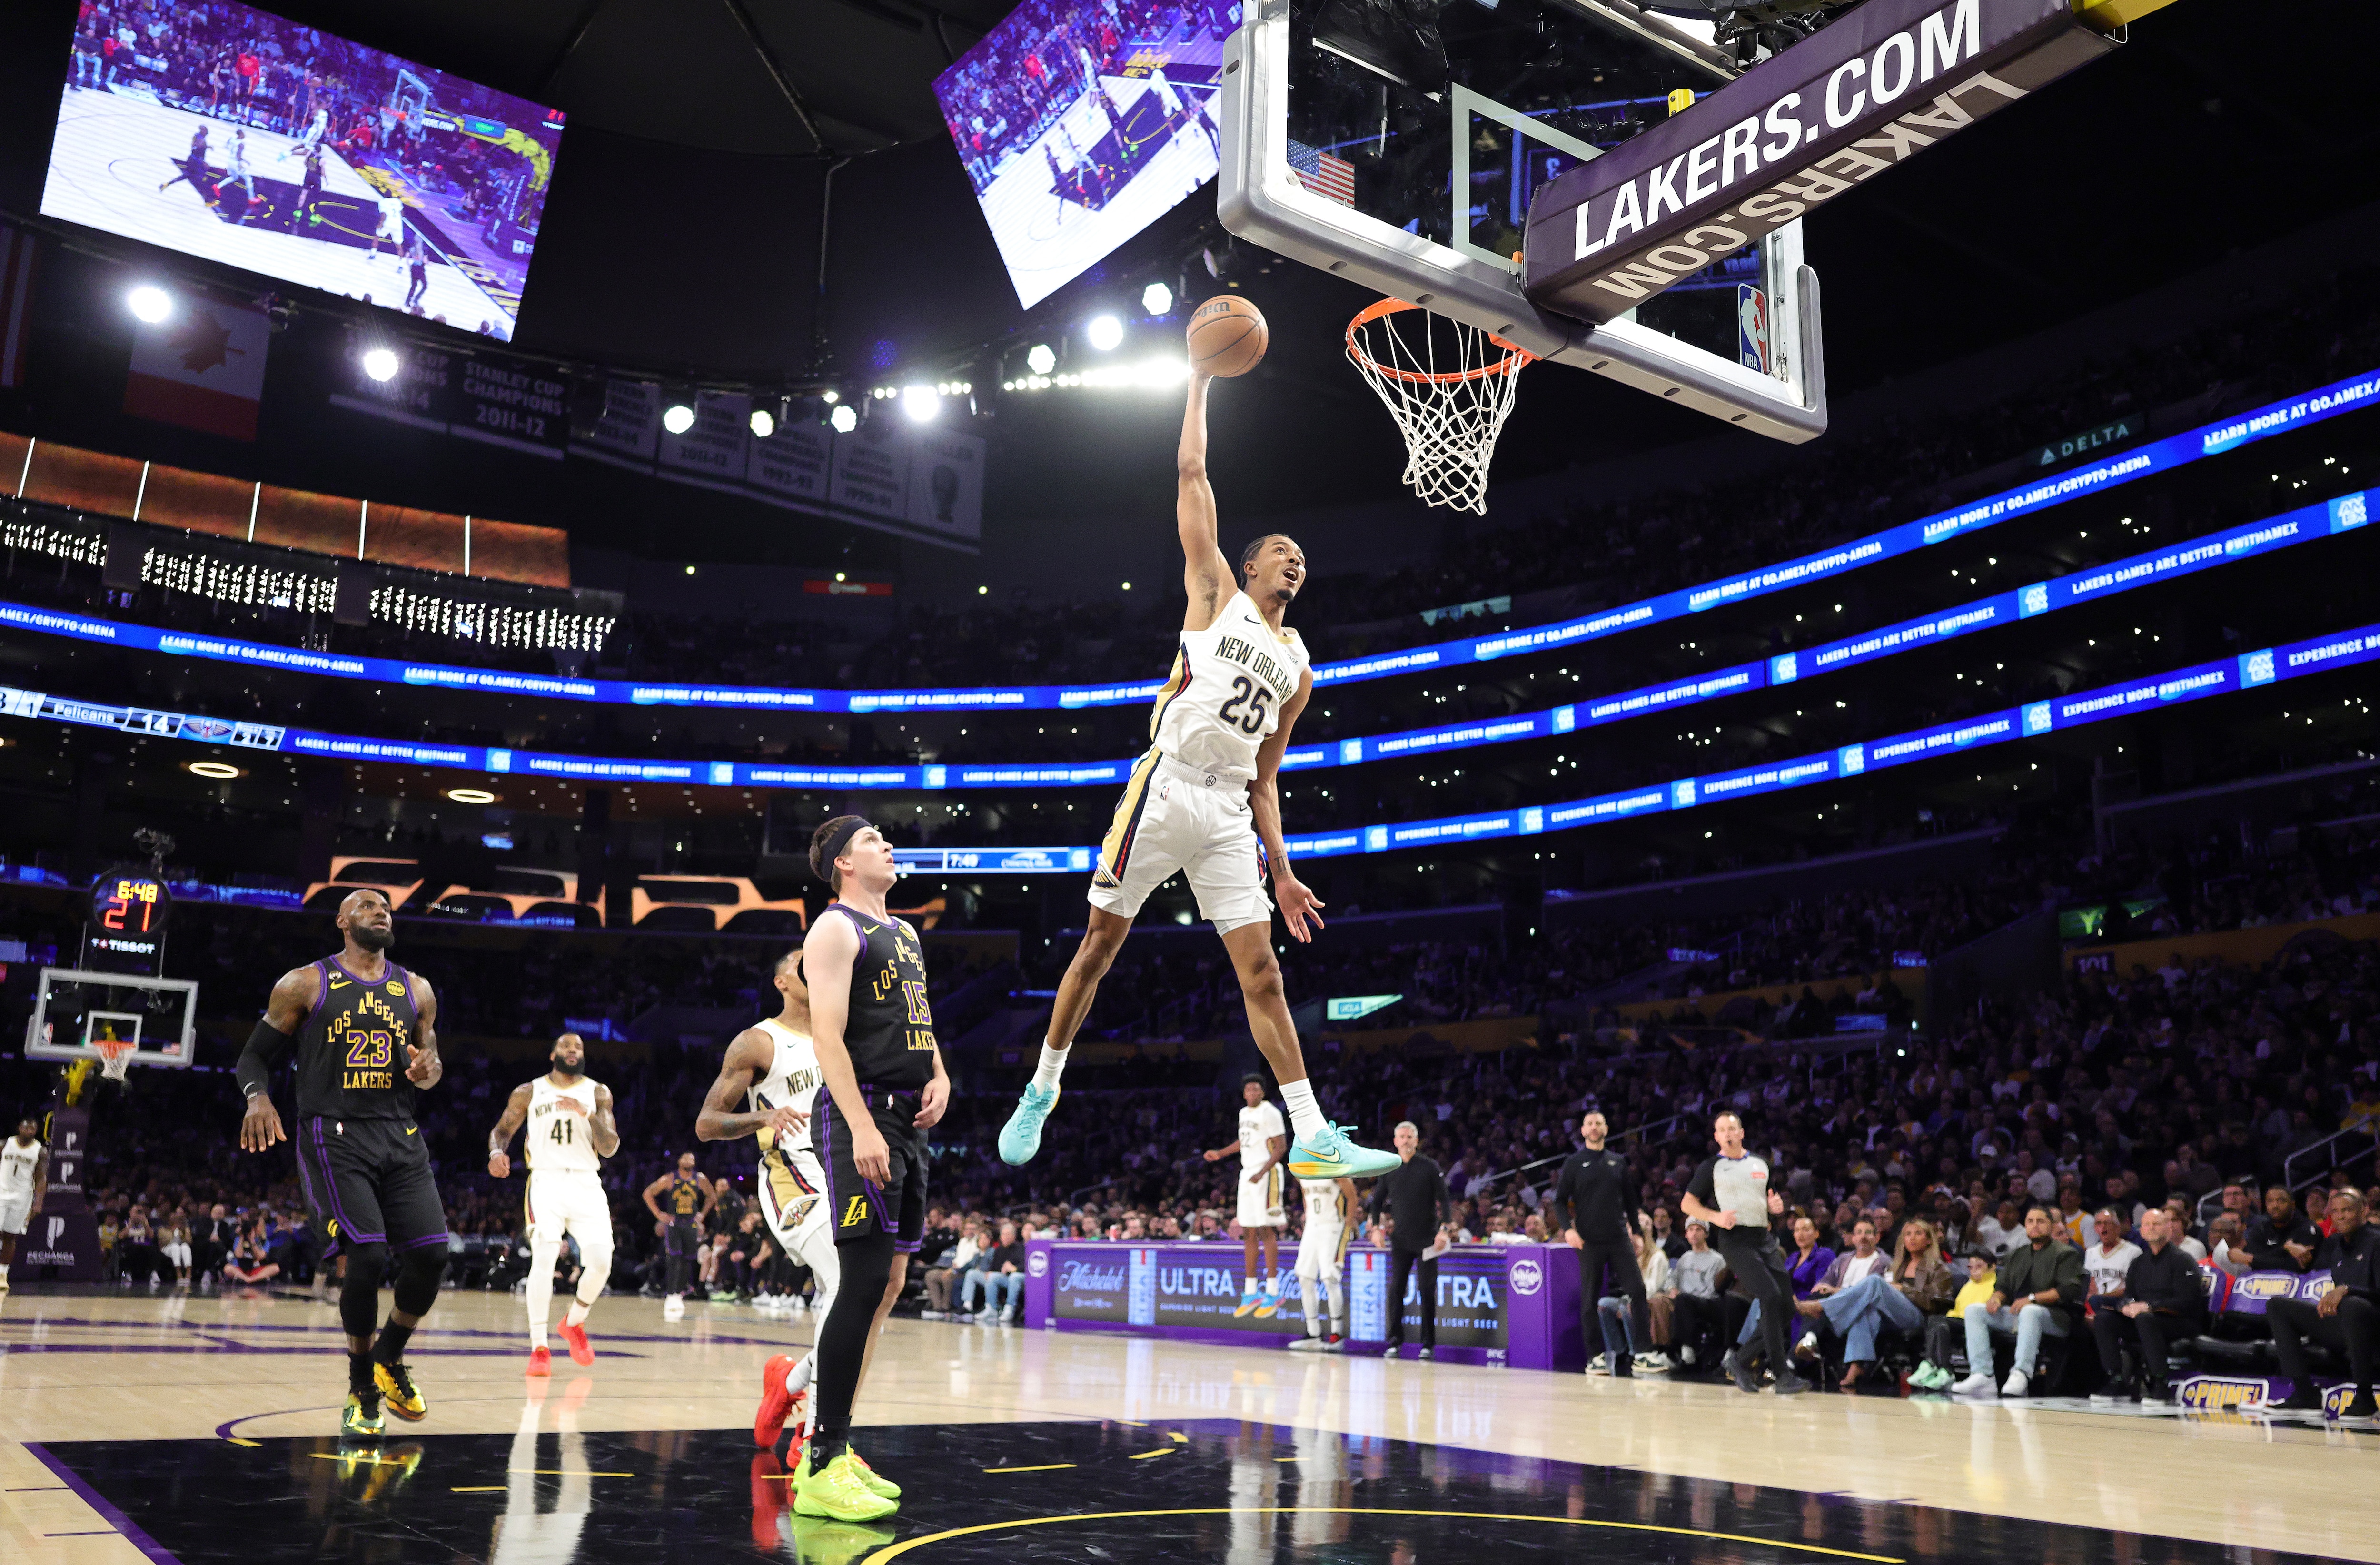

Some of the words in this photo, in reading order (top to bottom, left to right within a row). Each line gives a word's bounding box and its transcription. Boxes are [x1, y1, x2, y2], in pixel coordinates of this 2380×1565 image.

[1574, 0, 1981, 261] LAKERS.COM
[1592, 70, 2030, 299] LAKERS.COM
[1744, 351, 1759, 370] NBA
[465, 360, 530, 389] STANLEY
[533, 378, 565, 398] CUP
[463, 377, 563, 416] CHAMPIONS
[476, 403, 546, 438] 2011-12
[2205, 423, 2247, 447] LEARN
[2250, 410, 2288, 432] MORE
[2291, 403, 2307, 419] AT
[2061, 423, 2130, 456] DELTA
[1924, 517, 1958, 540] LEARN
[1960, 506, 1990, 525] MORE
[1992, 501, 2005, 515] AT
[2073, 574, 2113, 594] LAKERS
[2115, 563, 2153, 582] GAMES
[2156, 556, 2177, 571] ARE
[2180, 544, 2222, 565] BETTER
[1690, 588, 1720, 609] LEARN
[1721, 581, 1747, 597] MORE
[1749, 577, 1761, 590] AT
[161, 636, 195, 649] LEARN
[196, 641, 226, 654] MORE
[227, 645, 240, 655] AT
[1215, 636, 1255, 665] NEW
[1817, 647, 1849, 665] LAKERS
[1851, 639, 1881, 655] GAMES
[1883, 634, 1900, 647] ARE
[1902, 624, 1935, 642] BETTER
[2289, 639, 2363, 666] EXPERIENCE
[405, 668, 436, 680] LEARN
[437, 671, 465, 683] MORE
[466, 674, 478, 684] AT
[53, 702, 115, 724] Pelicans
[1219, 675, 1272, 735] 25
[1592, 703, 1621, 717] LAKERS
[1622, 696, 1649, 710] GAMES
[1650, 692, 1666, 703] ARE
[1667, 685, 1697, 700] BETTER
[141, 713, 169, 734] 14
[296, 738, 329, 750] LAKERS
[331, 742, 361, 753] GAMES
[363, 744, 379, 754] ARE
[381, 746, 413, 757] BETTER
[117, 880, 158, 903] 6:48
[104, 896, 151, 932] 21
[109, 939, 156, 955] TISSOT
[872, 959, 898, 1001] LOS
[894, 936, 927, 981] ANGEL
[2078, 955, 2109, 973] 101
[327, 1010, 351, 1043] LOS
[357, 991, 407, 1046] ANGELES
[901, 980, 932, 1027] 15
[346, 1029, 392, 1068] 23
[905, 1030, 934, 1051] LAKE
[342, 1071, 392, 1089] LAKERS
[786, 1067, 815, 1097] NEW
[535, 1101, 553, 1119] NEW
[550, 1119, 572, 1145] 41
[13, 1163, 18, 1177] 1
[840, 1195, 868, 1228] LA
[1313, 1198, 1321, 1214] 0
[1160, 1267, 1237, 1297] ULTRA
[1402, 1274, 1499, 1309] UTRA
[1441, 1317, 1470, 1328] LIGHT
[1473, 1318, 1498, 1330] BEER
